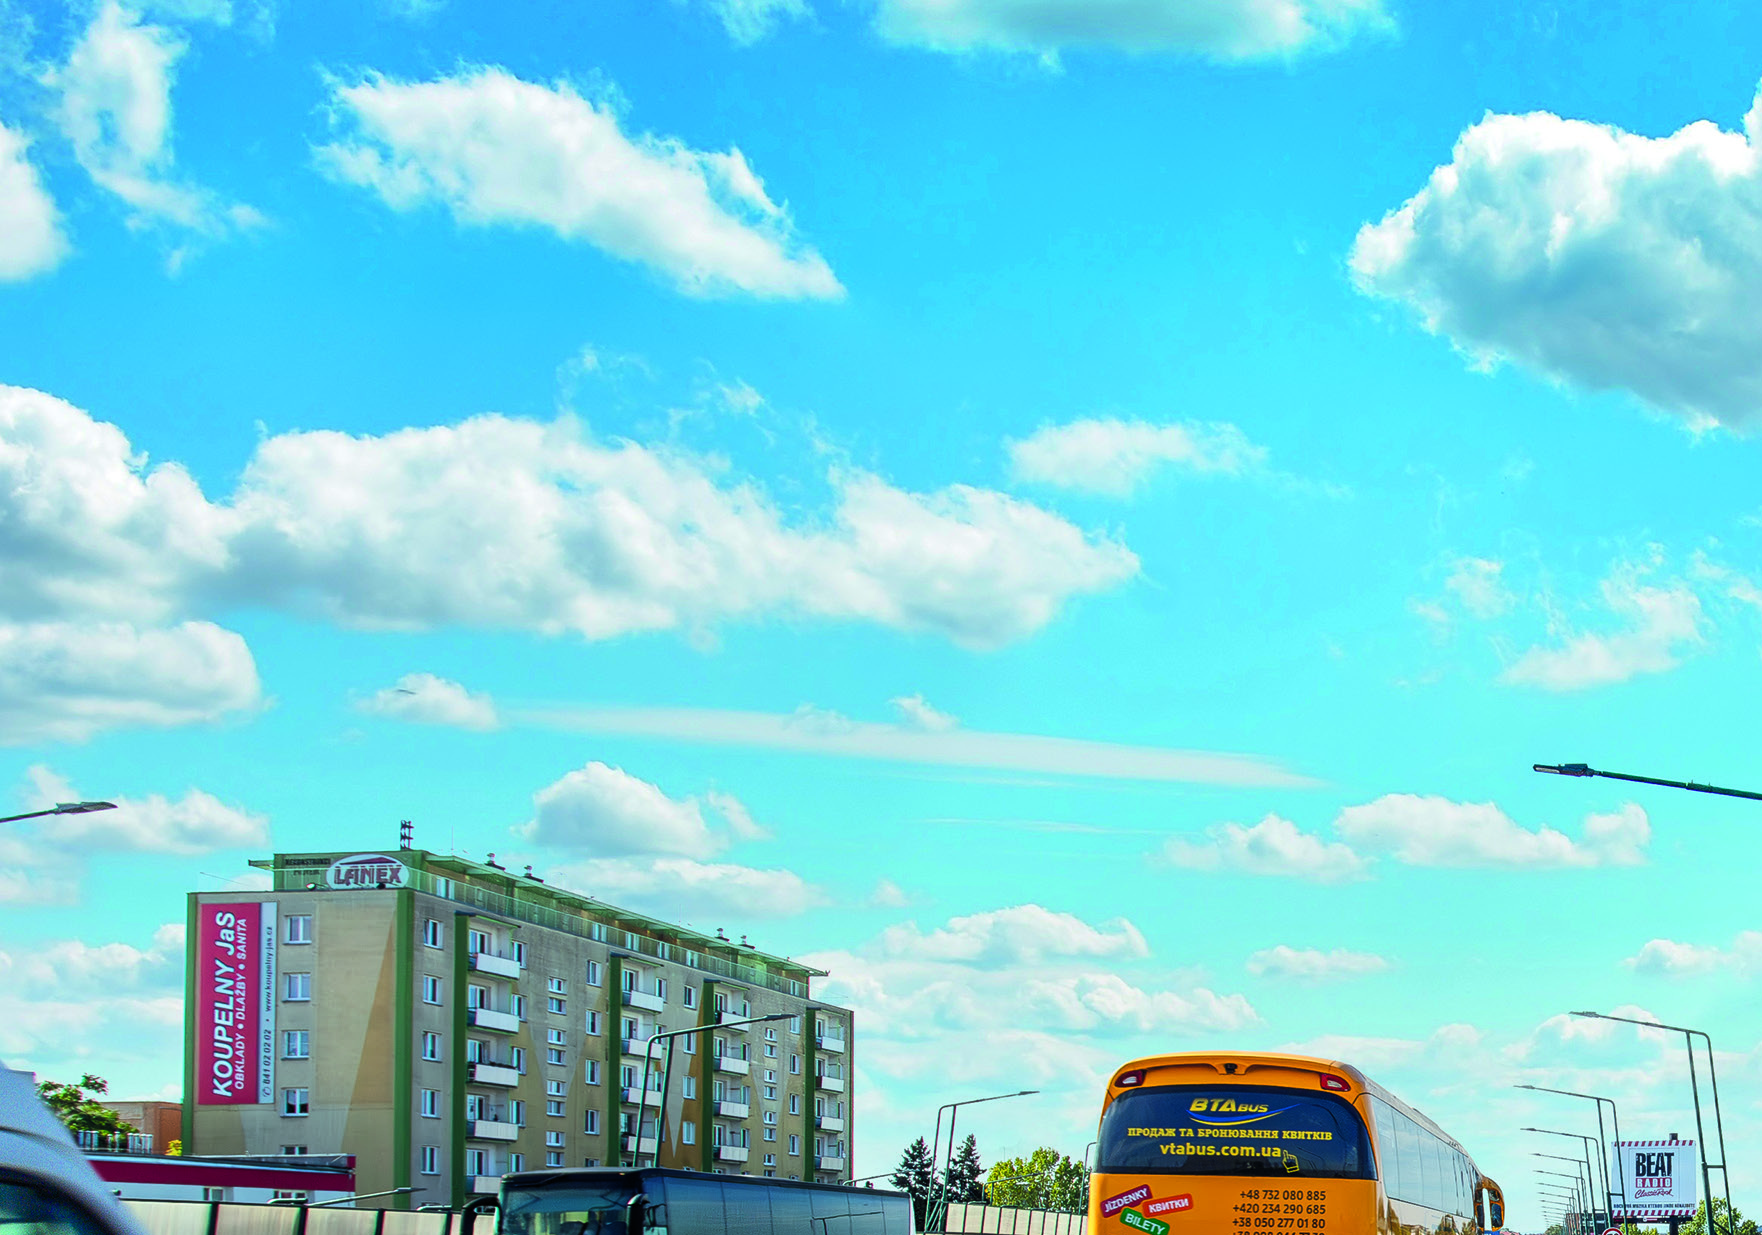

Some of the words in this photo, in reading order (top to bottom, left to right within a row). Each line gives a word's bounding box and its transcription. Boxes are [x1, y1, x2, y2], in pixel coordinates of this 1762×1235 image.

[334, 865, 402, 885] LANEX
[215, 911, 236, 956] JaS
[236, 918, 247, 960] SANITA
[235, 974, 246, 1020] DLAŽBY
[212, 959, 235, 1097] KOUPELNY
[235, 1033, 245, 1090] OBKLADY
[1127, 1127, 1176, 1138] ПРОДАЖ
[1179, 1128, 1194, 1137] ТА
[1197, 1128, 1279, 1139] БРОНЮВАННЯ
[1282, 1130, 1333, 1140] КВИТКІВ
[1160, 1143, 1282, 1158] vtabus.com.ua
[1635, 1152, 1674, 1177] BEAT
[1637, 1178, 1671, 1187] RADIO
[1104, 1187, 1149, 1213] JÍZDENKY
[1240, 1190, 1260, 1200] +48
[1263, 1190, 1280, 1200] 732
[1283, 1190, 1304, 1200] 080
[1306, 1190, 1327, 1200] 885
[1148, 1199, 1189, 1214] КВИТКИ
[1233, 1204, 1260, 1214] +420
[1262, 1204, 1281, 1214] 234
[1283, 1204, 1304, 1214] 290
[1306, 1204, 1326, 1214] 685
[1124, 1213, 1166, 1235] BILETY
[1232, 1218, 1252, 1228] +38
[1254, 1218, 1275, 1228] 050
[1277, 1218, 1296, 1228] 277
[1297, 1218, 1308, 1228] 01
[1310, 1218, 1326, 1228] 80
